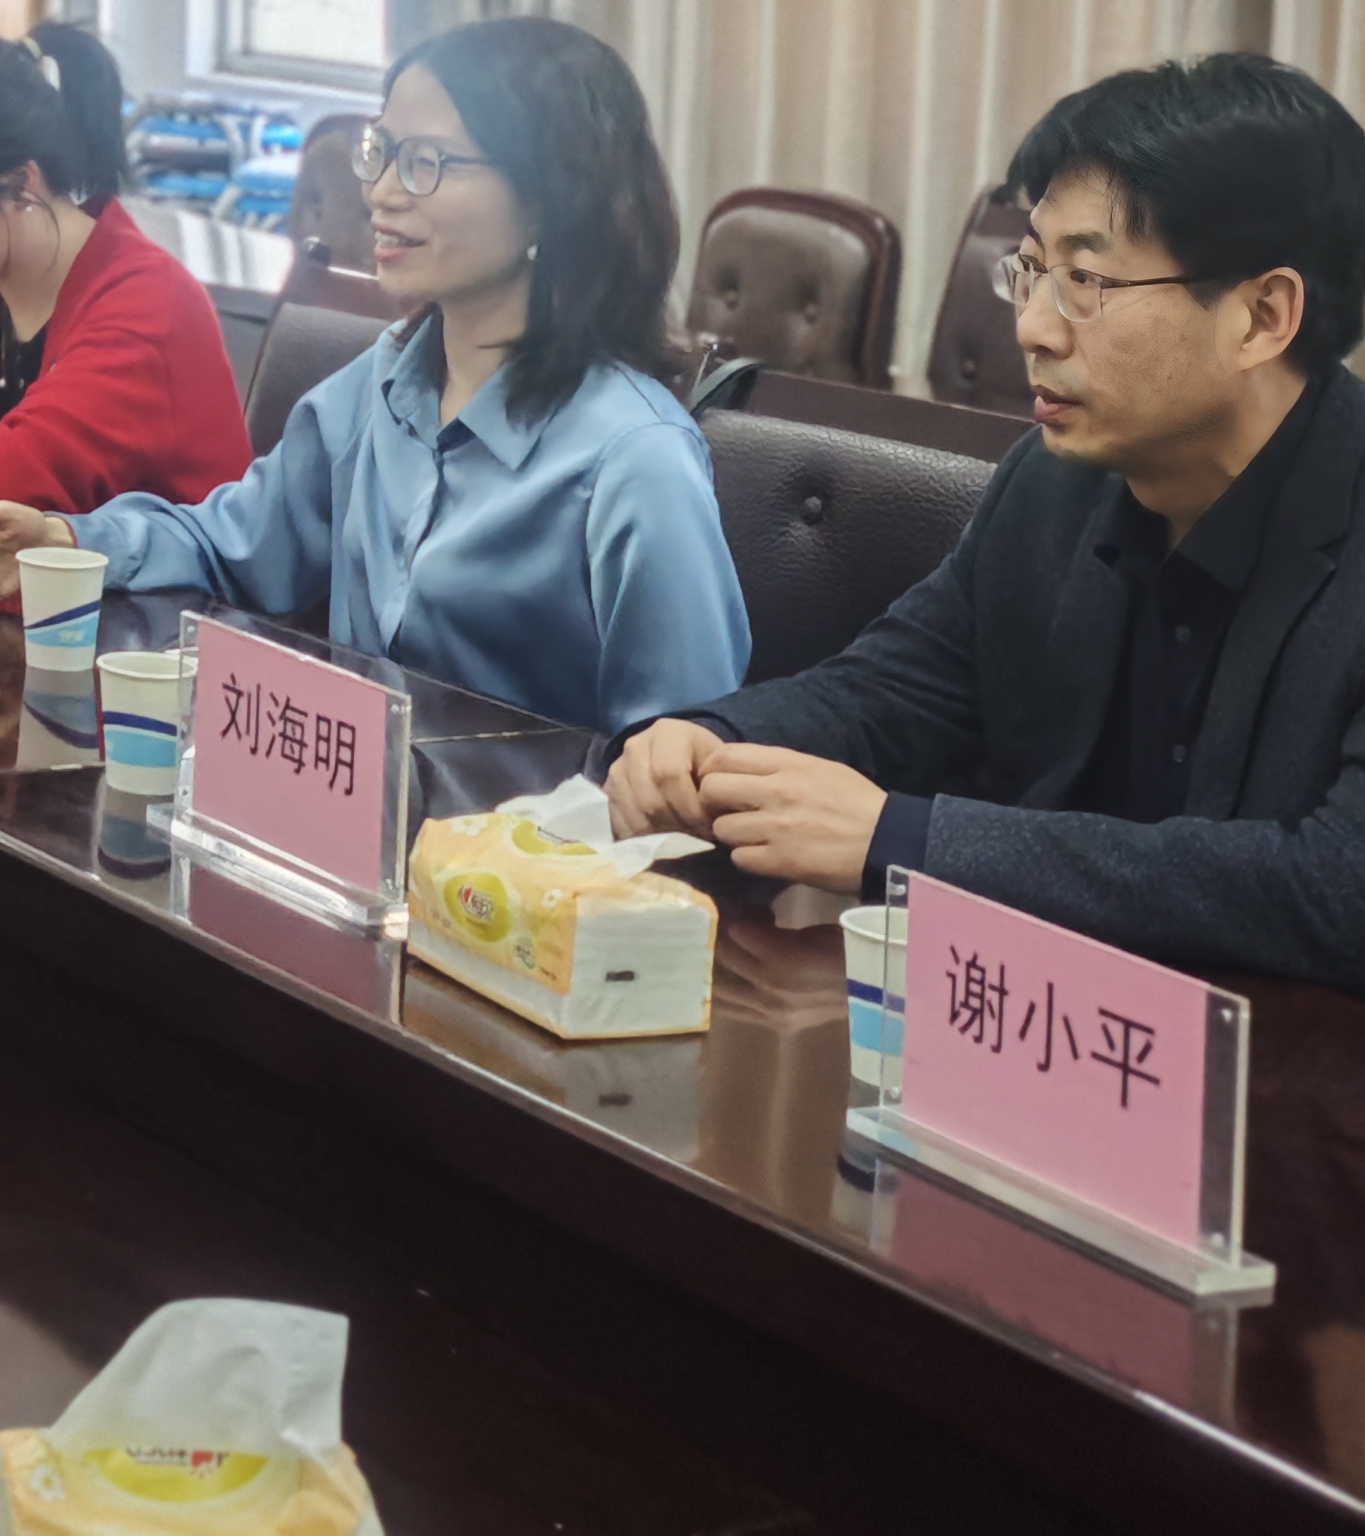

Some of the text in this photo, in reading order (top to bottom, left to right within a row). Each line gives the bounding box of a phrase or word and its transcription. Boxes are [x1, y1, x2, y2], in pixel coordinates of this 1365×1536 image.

[220, 671, 359, 798] 刘海明
[946, 944, 1162, 1110] 谢小平
